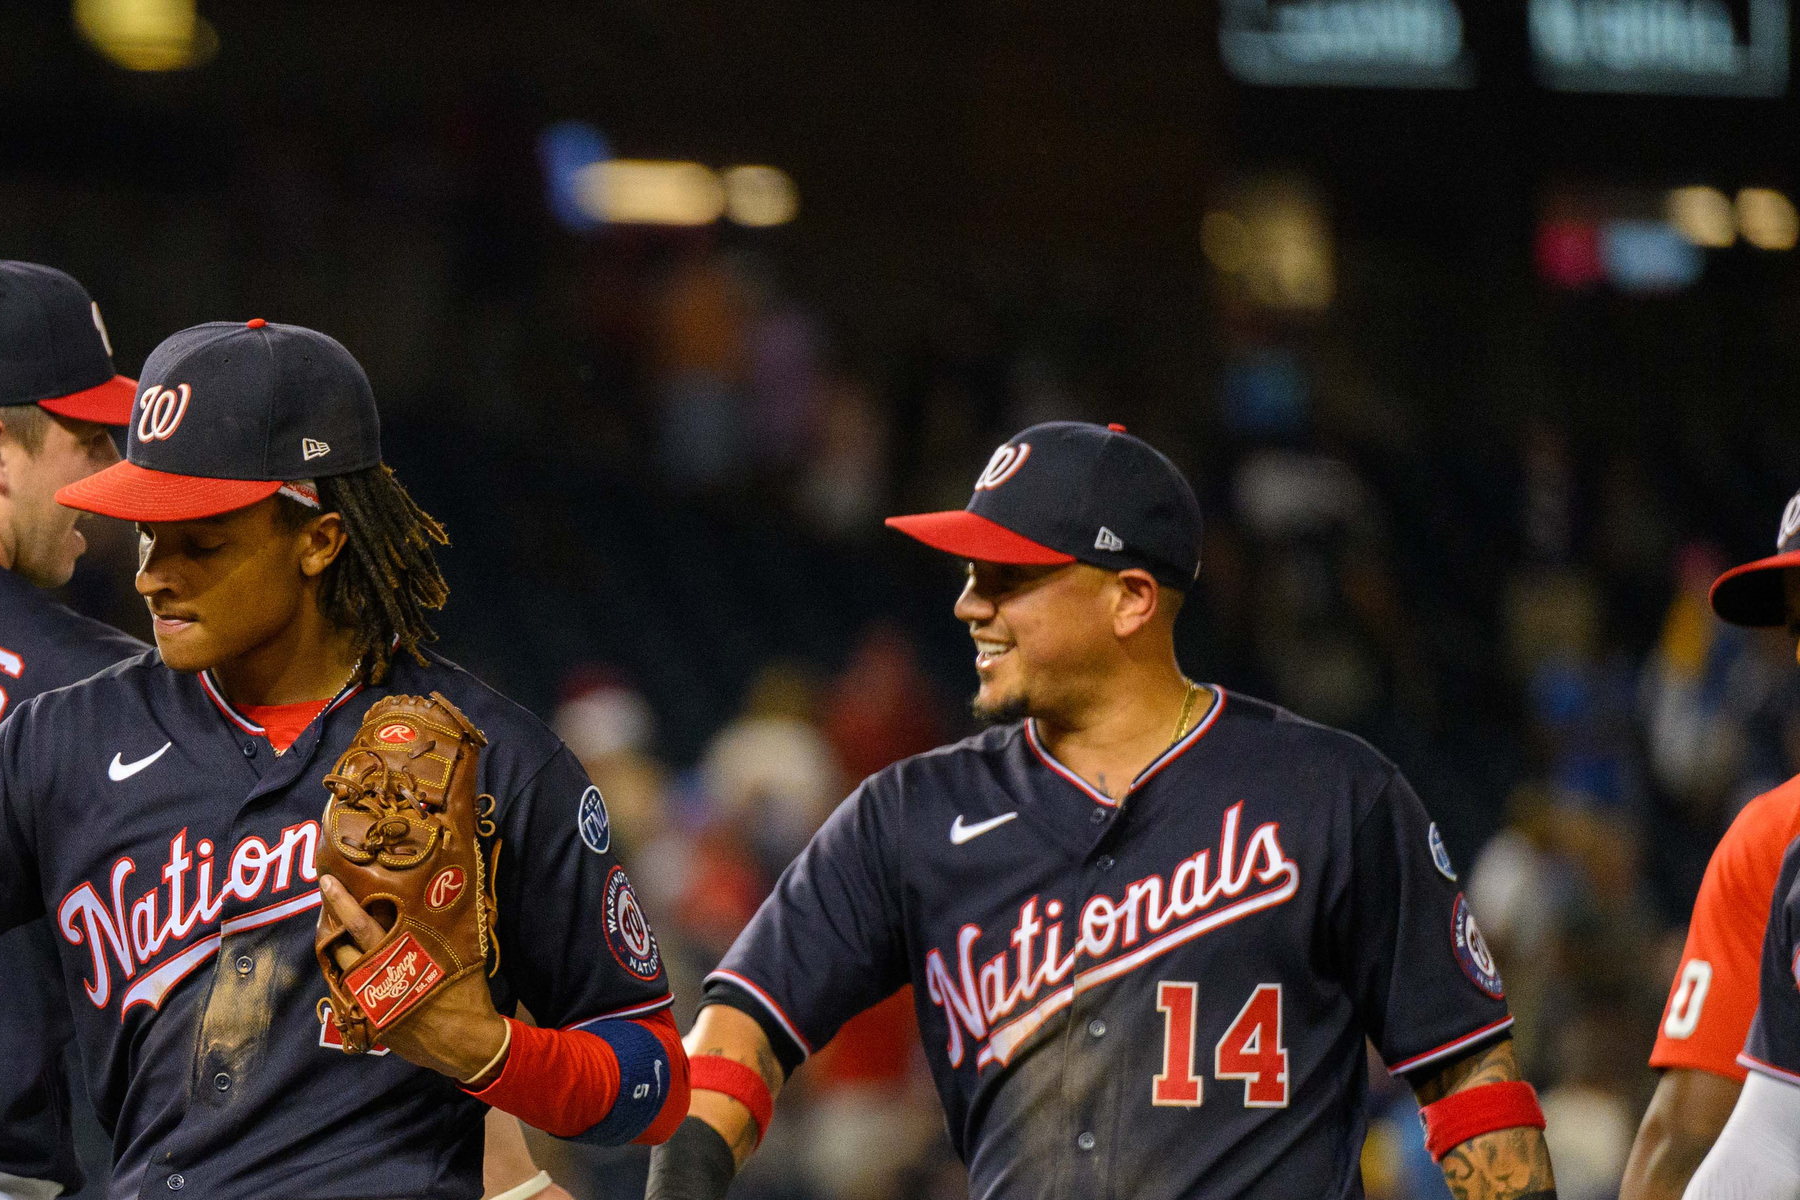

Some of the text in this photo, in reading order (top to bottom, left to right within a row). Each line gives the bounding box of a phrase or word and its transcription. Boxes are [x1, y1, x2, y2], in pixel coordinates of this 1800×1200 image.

[137, 386, 192, 444] W
[583, 800, 608, 845] TNL
[57, 819, 322, 1022] Nation
[926, 799, 1300, 1073] Nationals
[364, 951, 418, 1009] Rawlings
[1152, 980, 1290, 1108] 14
